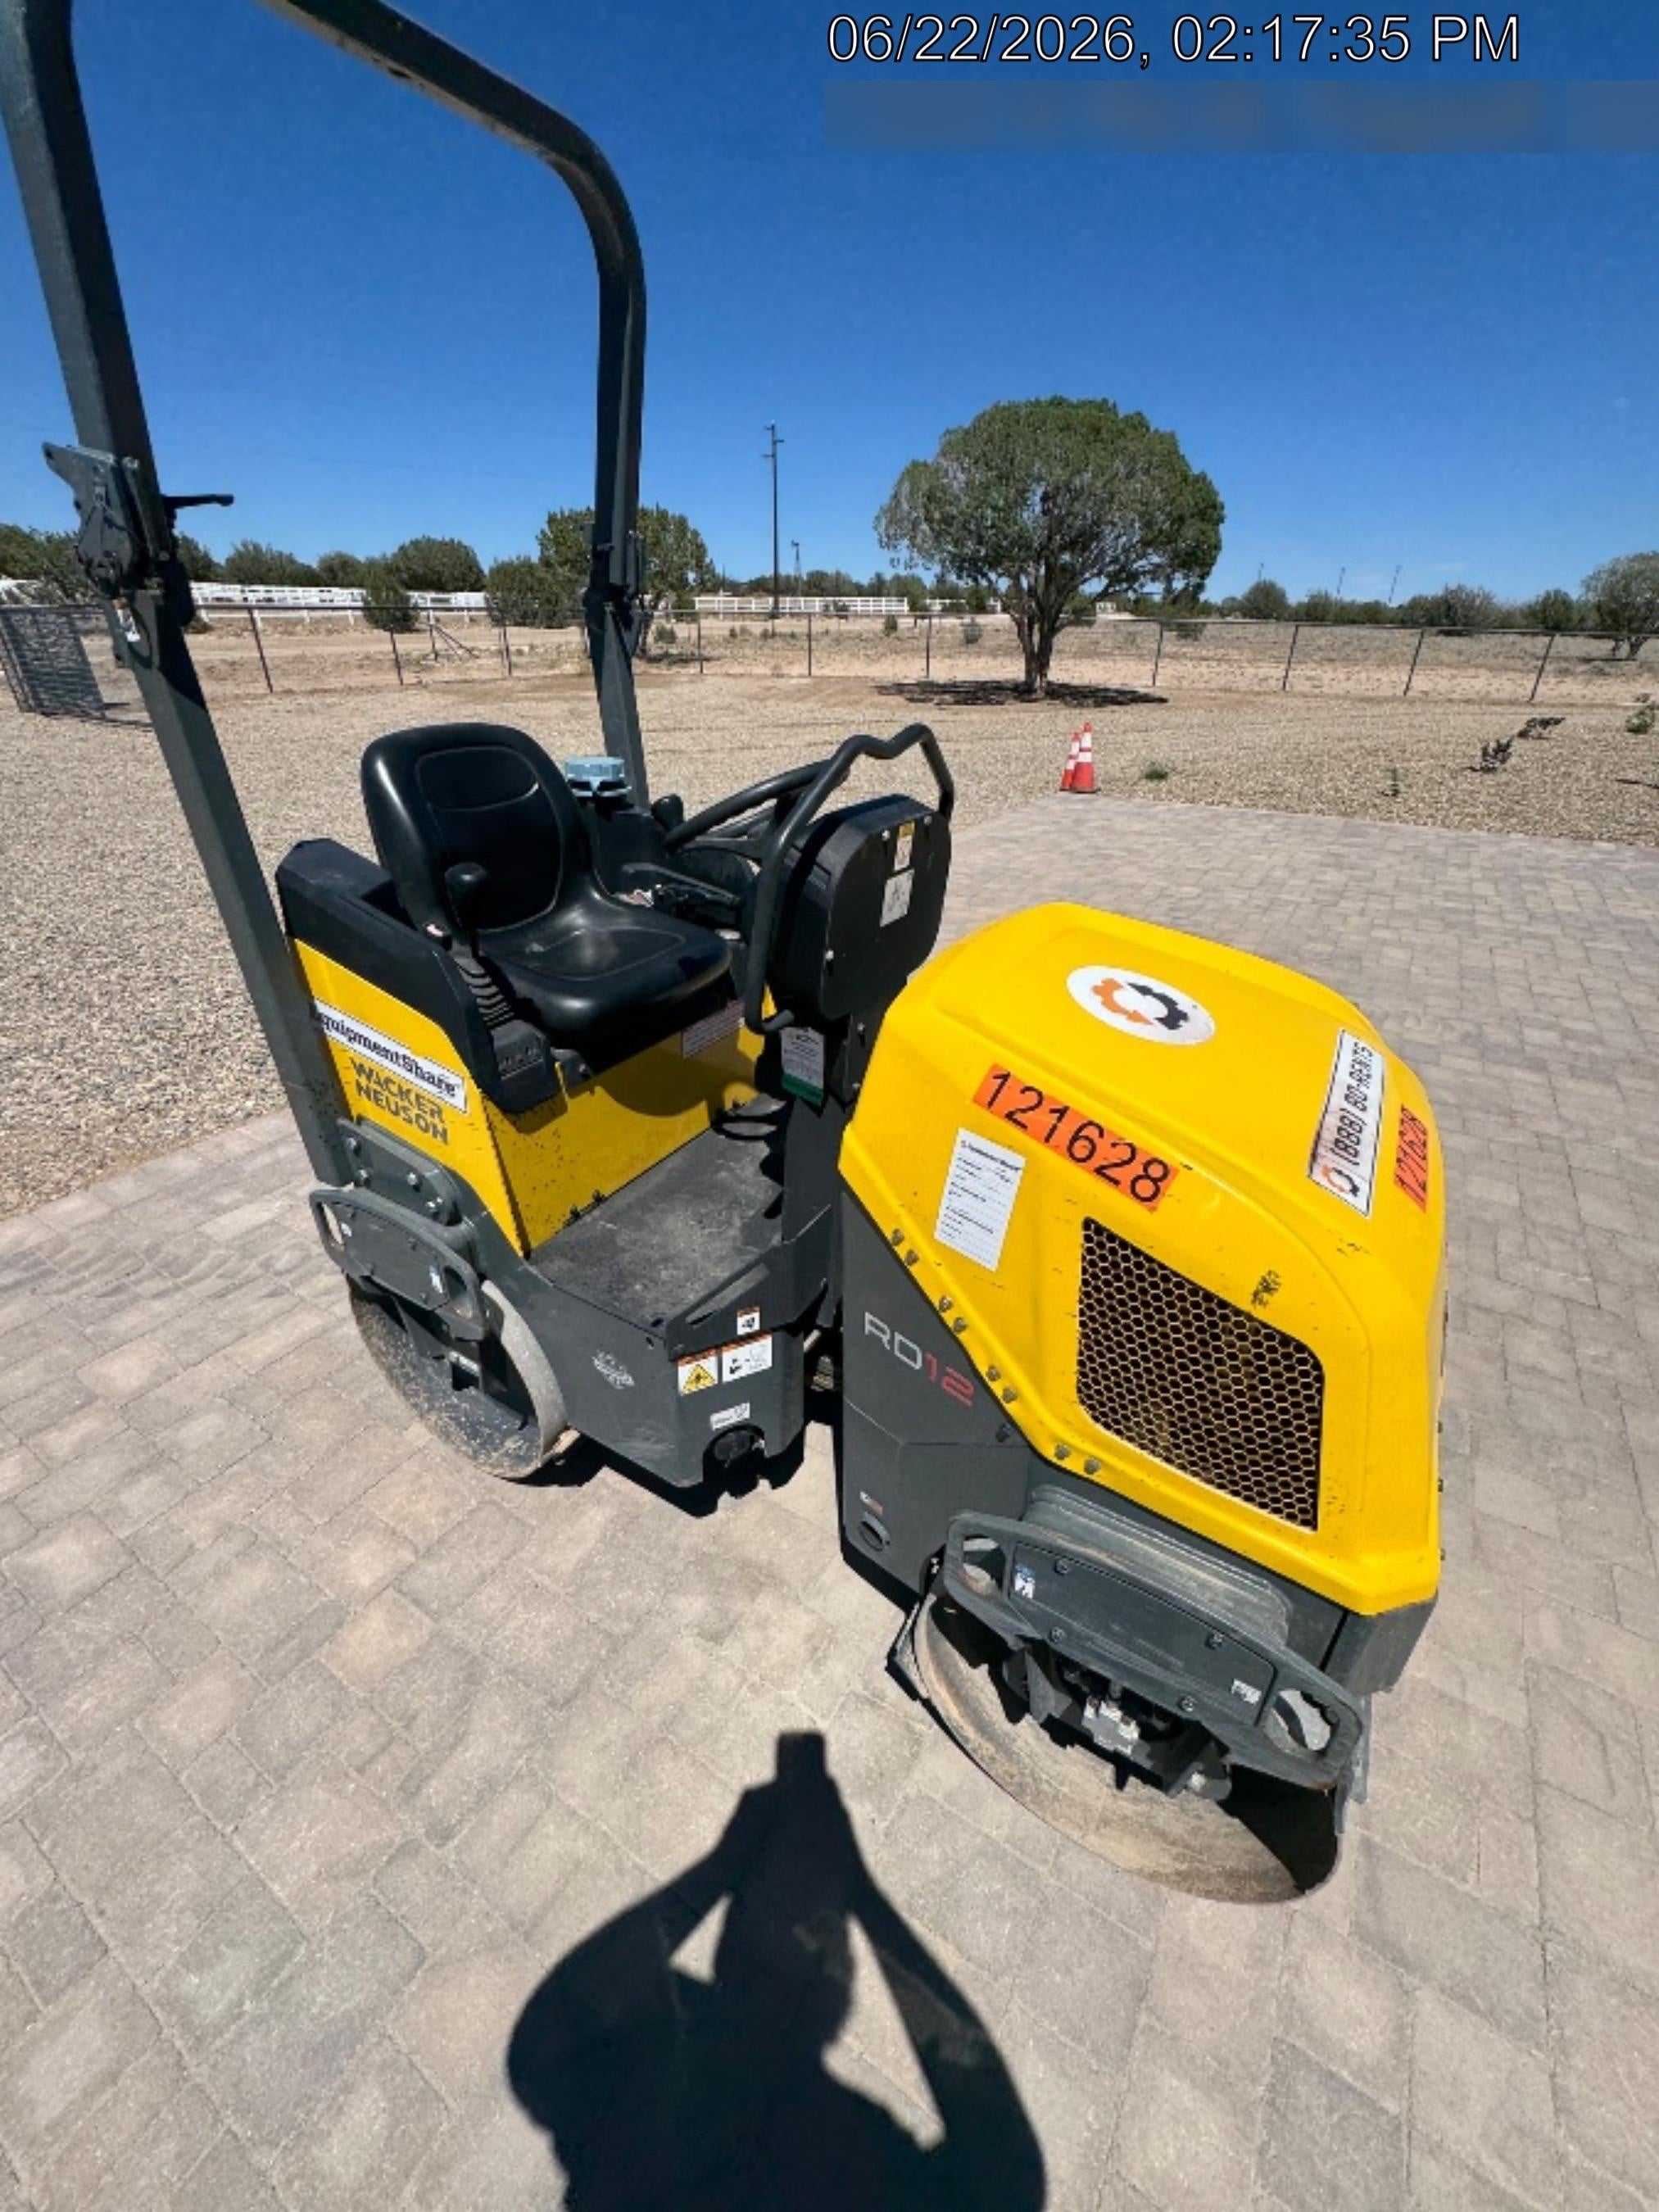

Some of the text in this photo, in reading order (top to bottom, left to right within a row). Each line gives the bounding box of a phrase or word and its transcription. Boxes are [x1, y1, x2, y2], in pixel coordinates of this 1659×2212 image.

[316, 1013, 456, 1097] quipmentShare
[349, 1057, 445, 1123] WACKER
[356, 1078, 448, 1145] NEUSON
[986, 1071, 1171, 1203] 121628
[864, 1311, 975, 1407] RD12
